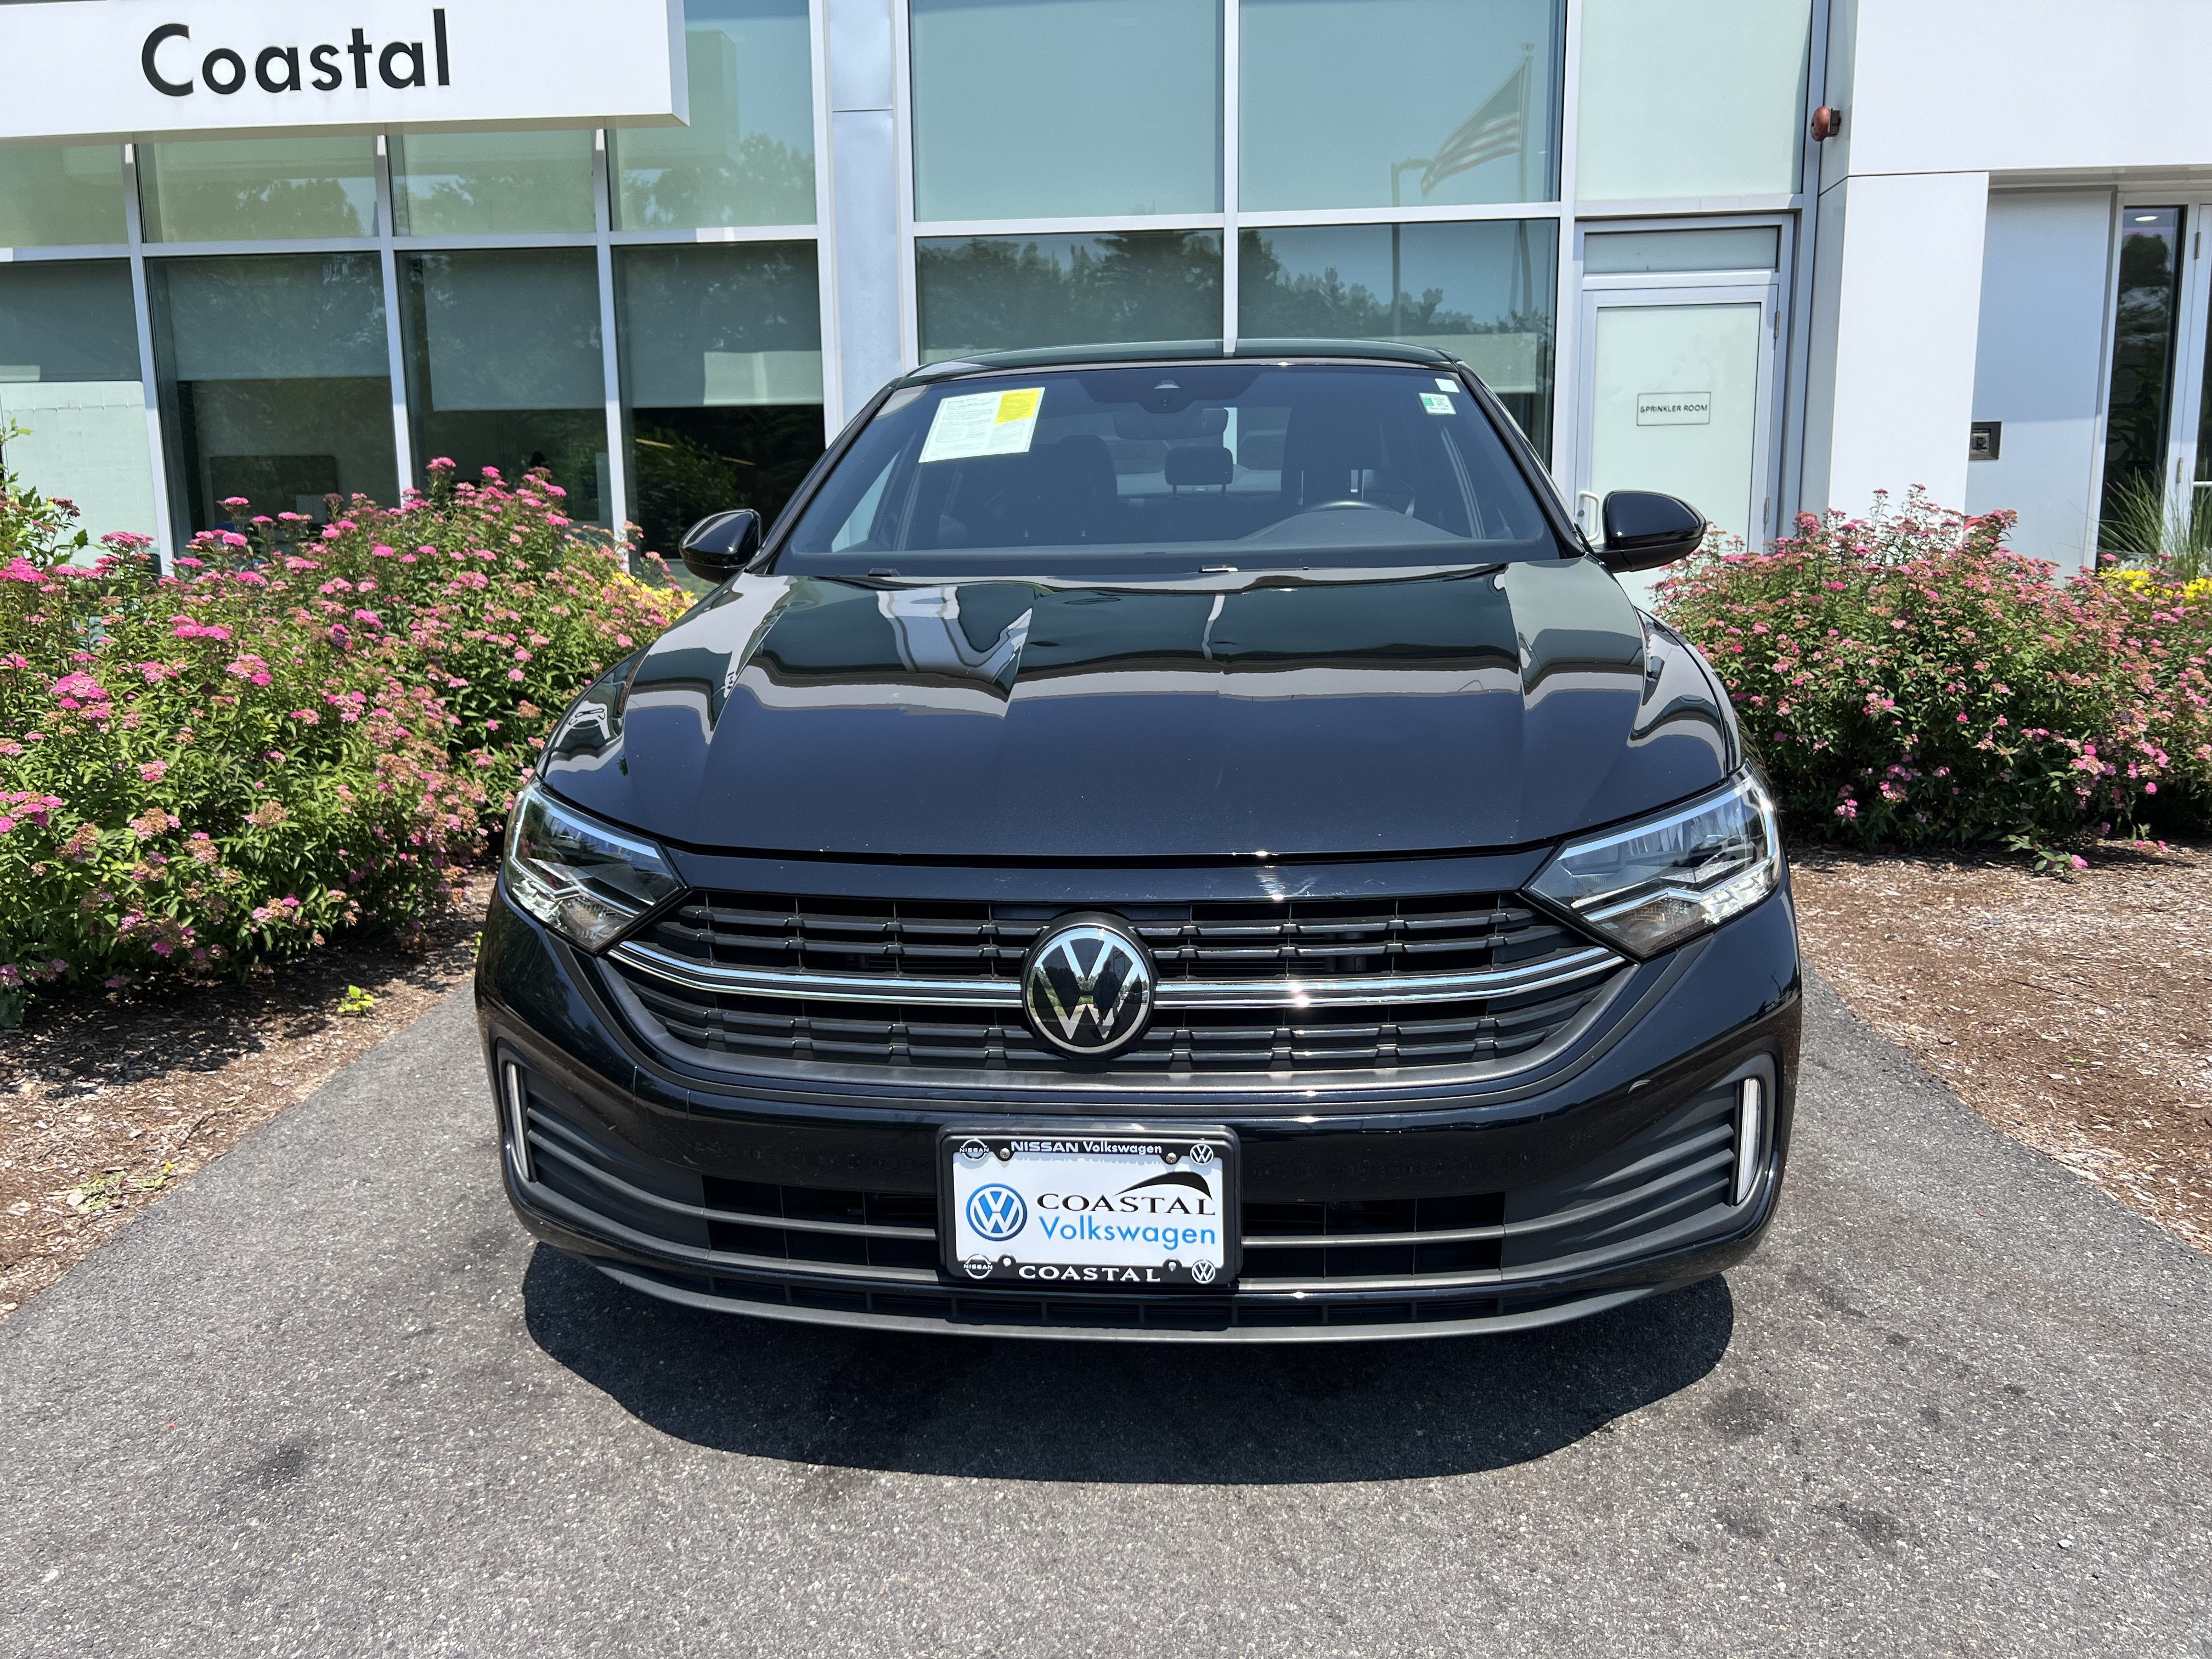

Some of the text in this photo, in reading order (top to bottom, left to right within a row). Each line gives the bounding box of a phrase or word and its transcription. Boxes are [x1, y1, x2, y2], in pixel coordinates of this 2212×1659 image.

[142, 8, 450, 97] Coastal
[1011, 1141, 1162, 1155] NISSAN Volkswagen
[1037, 1193, 1216, 1215] COASTAL
[1039, 1215, 1215, 1250] Volkswagen
[1018, 1266, 1160, 1282] COASTAL
